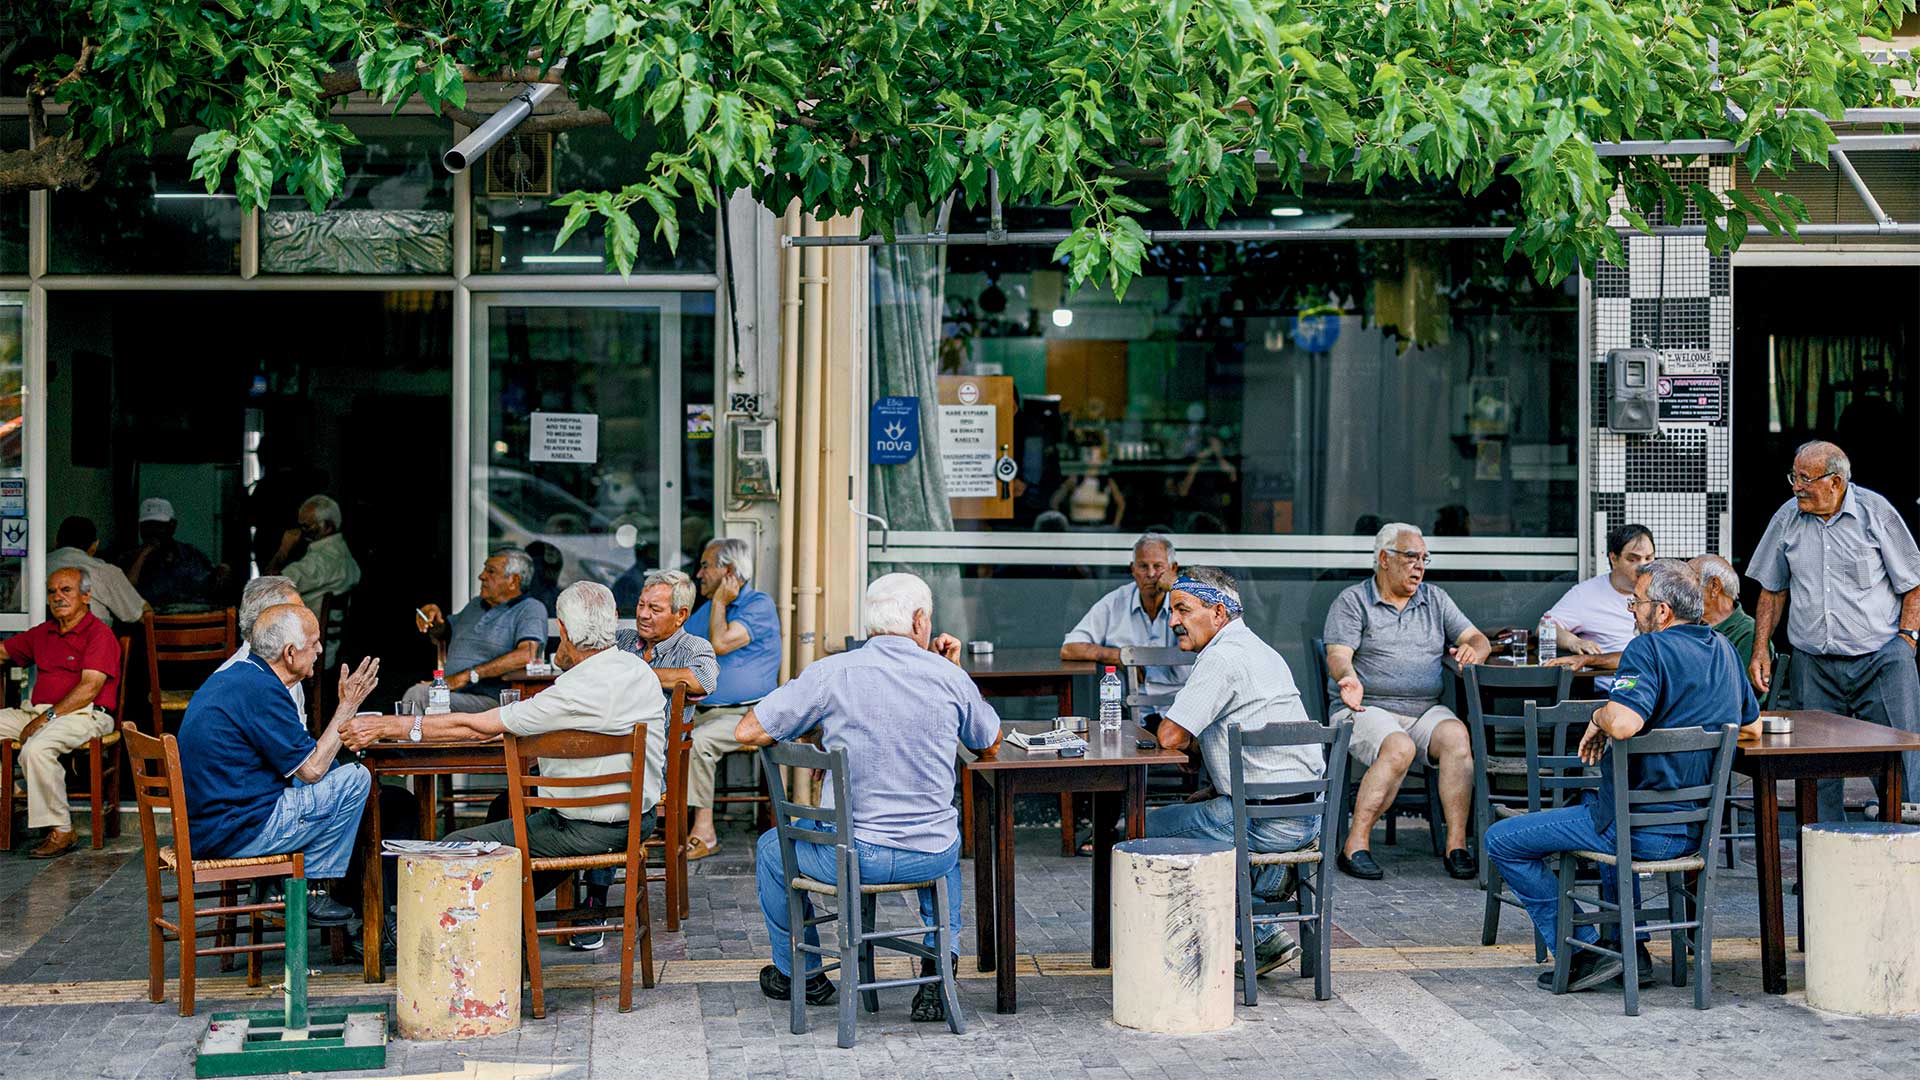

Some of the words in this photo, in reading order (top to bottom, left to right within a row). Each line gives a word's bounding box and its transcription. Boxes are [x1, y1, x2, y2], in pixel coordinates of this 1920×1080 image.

[1674, 352, 1711, 361] WELCOME
[736, 396, 756, 410] 26
[876, 440, 912, 451] nova
